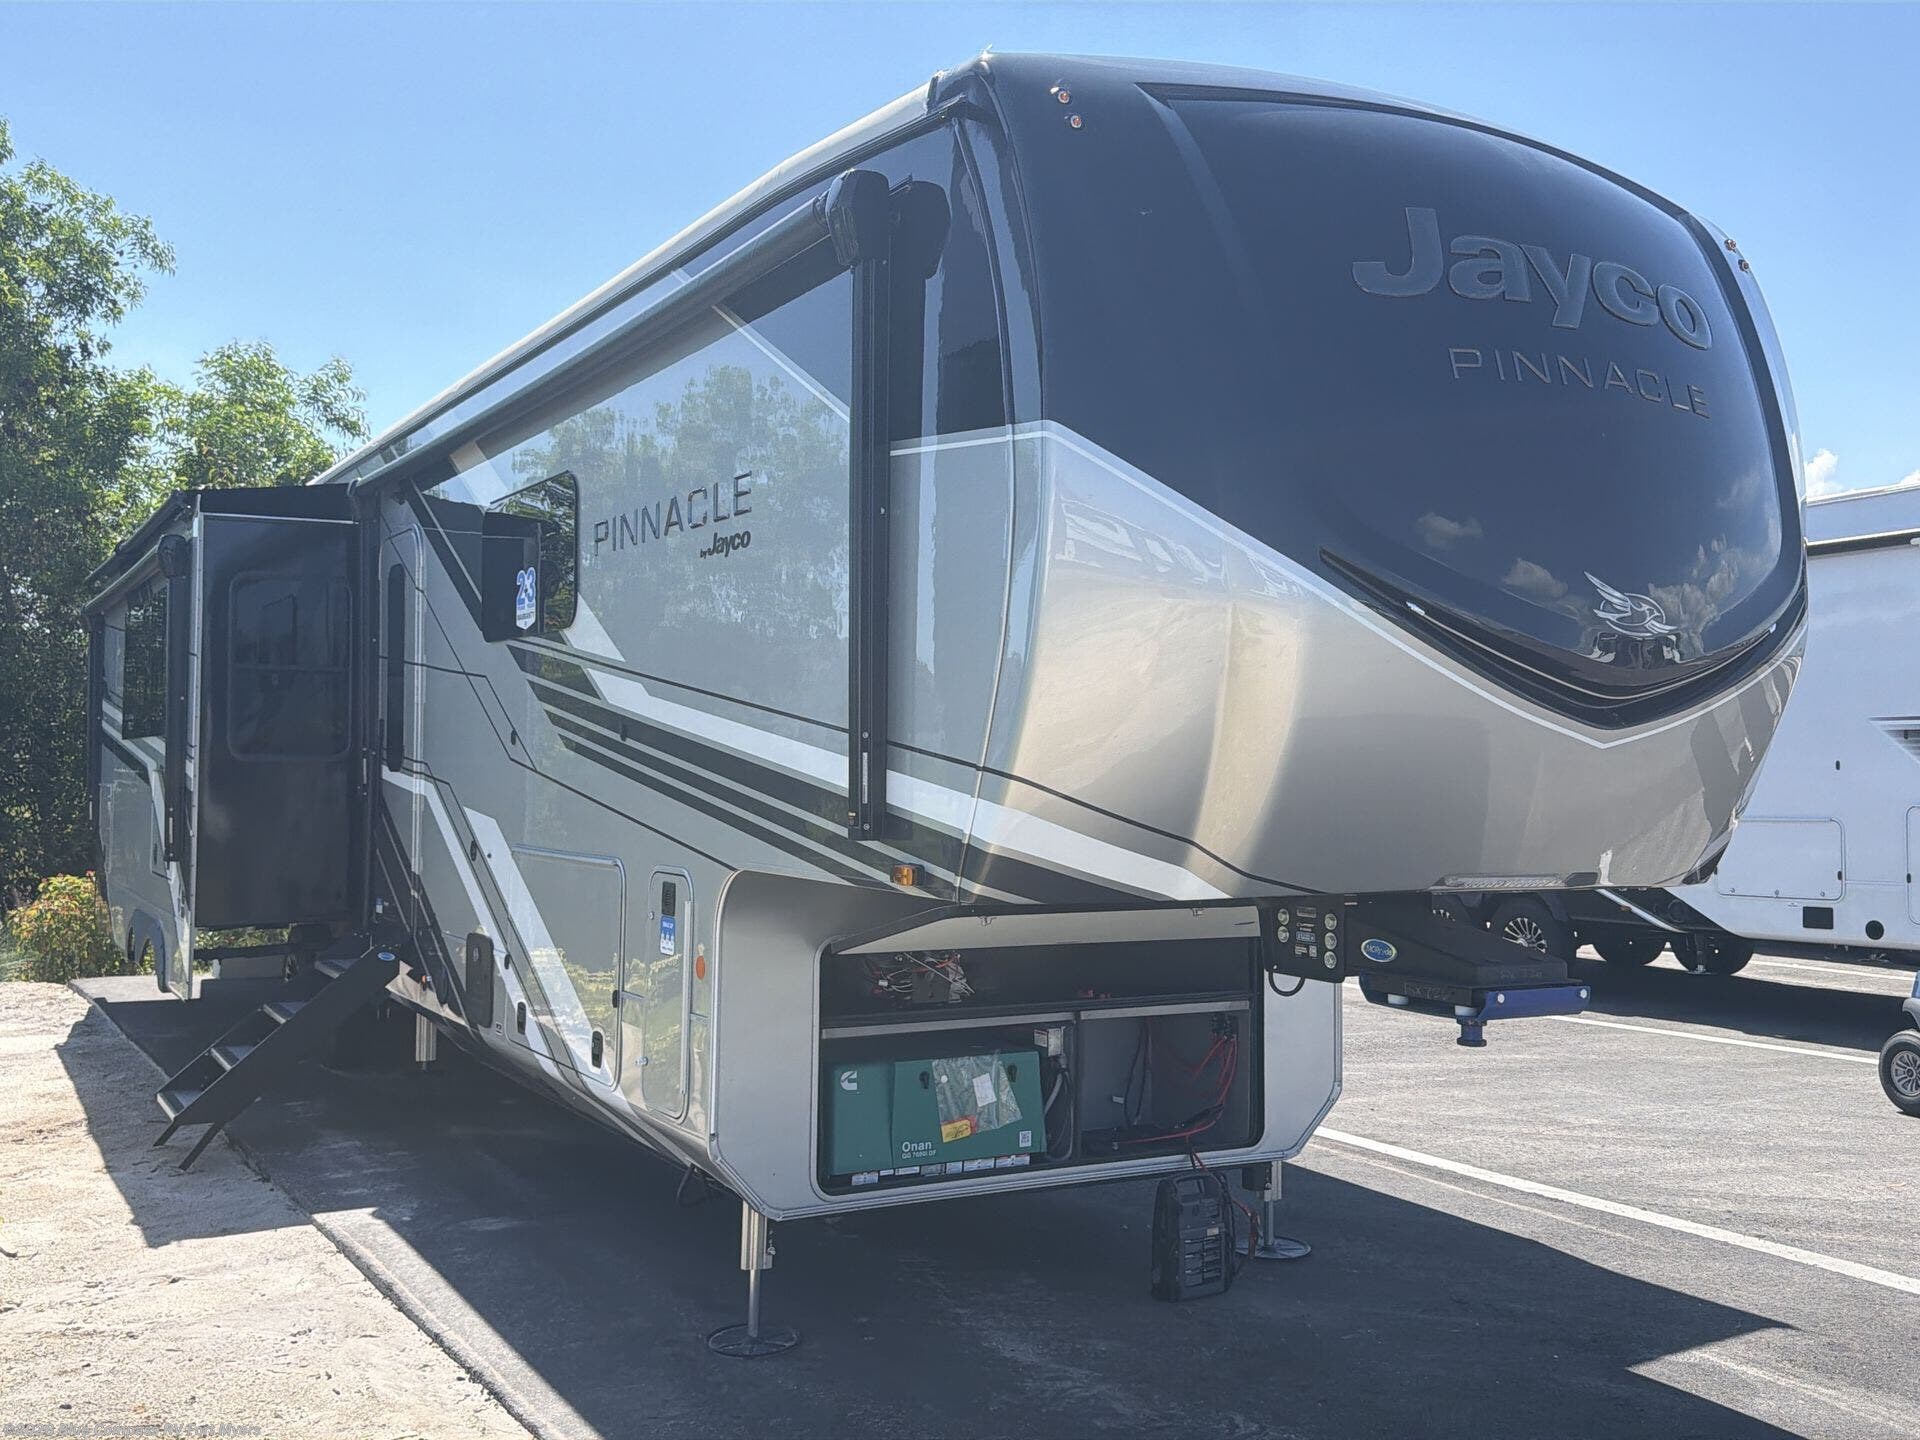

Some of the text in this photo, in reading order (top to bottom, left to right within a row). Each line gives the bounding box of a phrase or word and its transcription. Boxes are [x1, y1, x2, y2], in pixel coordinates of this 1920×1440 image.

[1352, 207, 1713, 351] Jayco
[1448, 346, 1711, 419] PINNACLE
[594, 470, 752, 557] PINNACLE
[707, 530, 751, 558] Jayco
[902, 1141, 932, 1152] Onan
